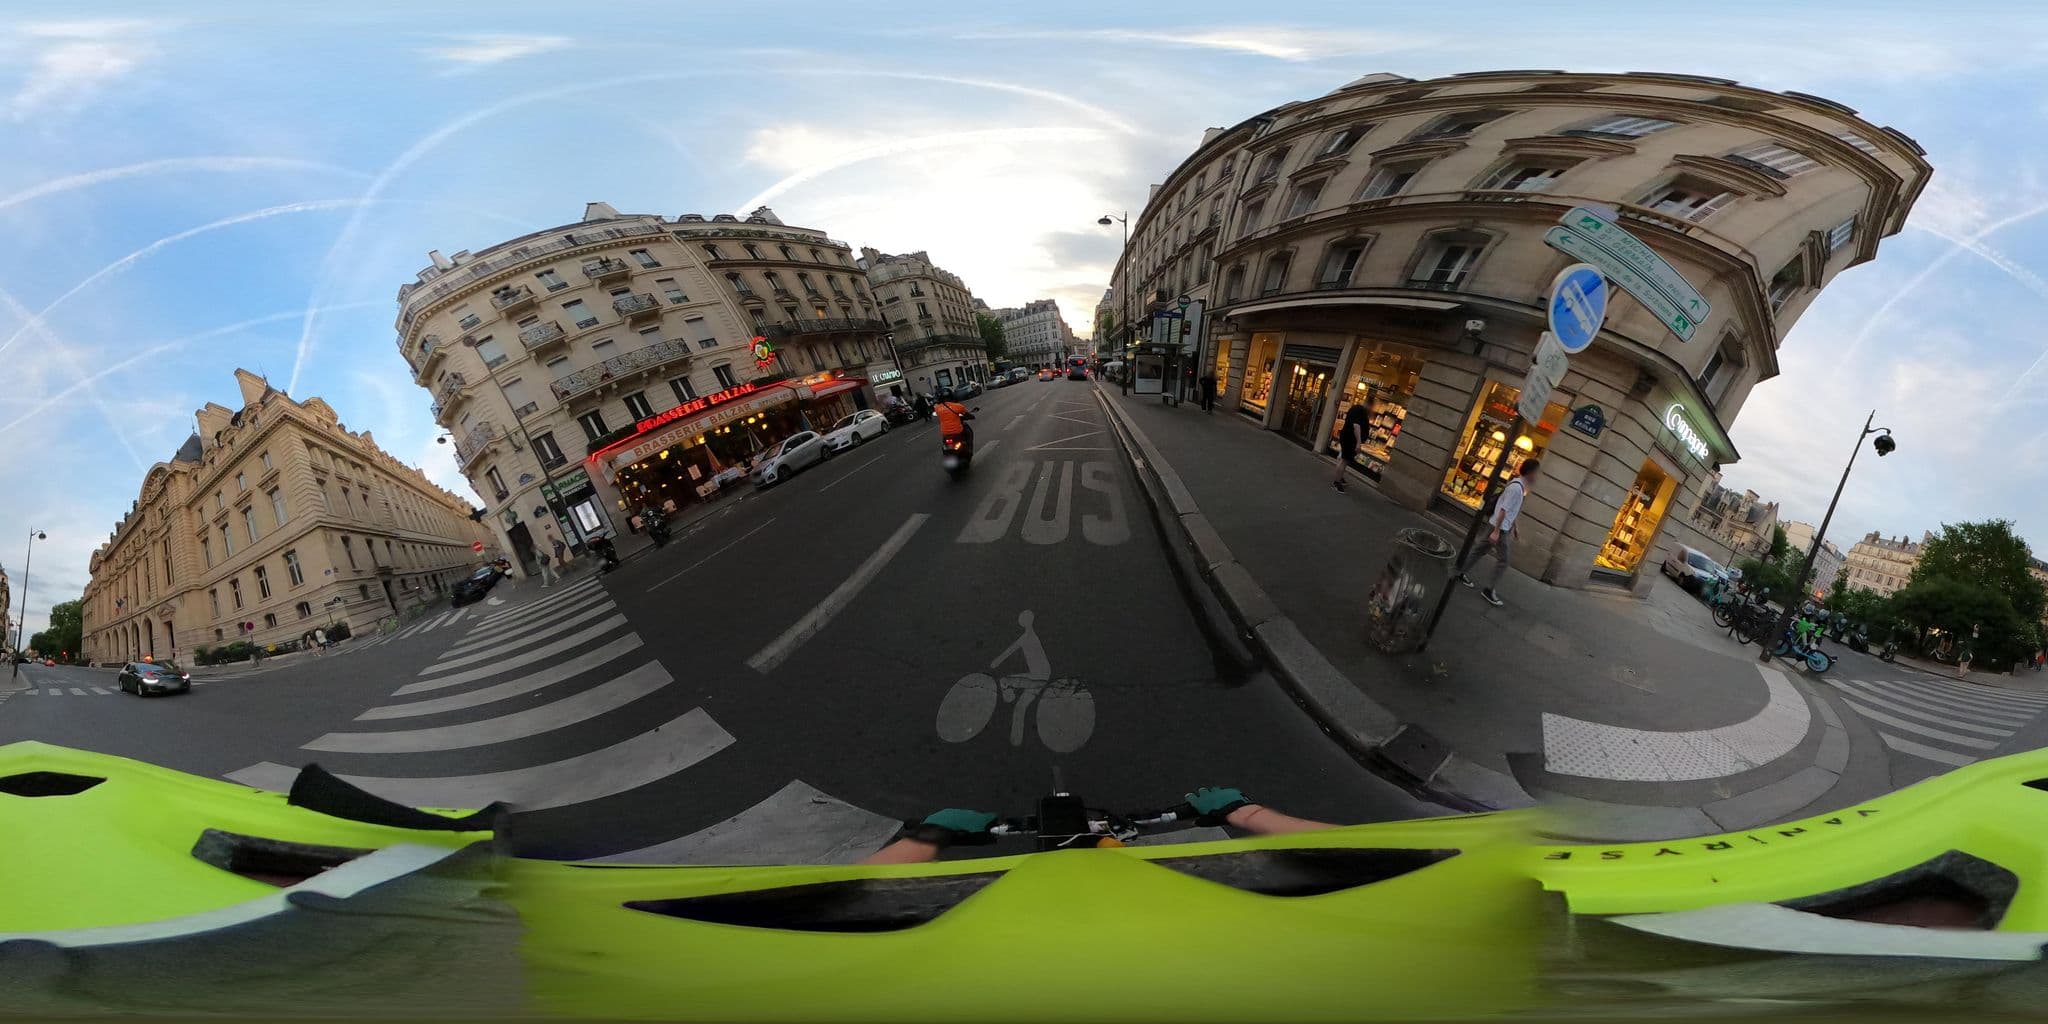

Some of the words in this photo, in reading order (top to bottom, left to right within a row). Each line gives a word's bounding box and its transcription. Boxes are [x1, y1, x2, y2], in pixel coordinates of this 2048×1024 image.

[1620, 236, 1656, 264] MICHEL
[1642, 289, 1673, 318] Sorbonne
[872, 374, 879, 383] LE
[633, 420, 704, 457] BRASSERIE
[709, 403, 753, 425] BALZAR
[637, 399, 707, 432] BRASSERIE
[709, 383, 756, 405] BALZAR
[1667, 403, 1709, 460] Compagnie
[955, 460, 1132, 546] BUS
